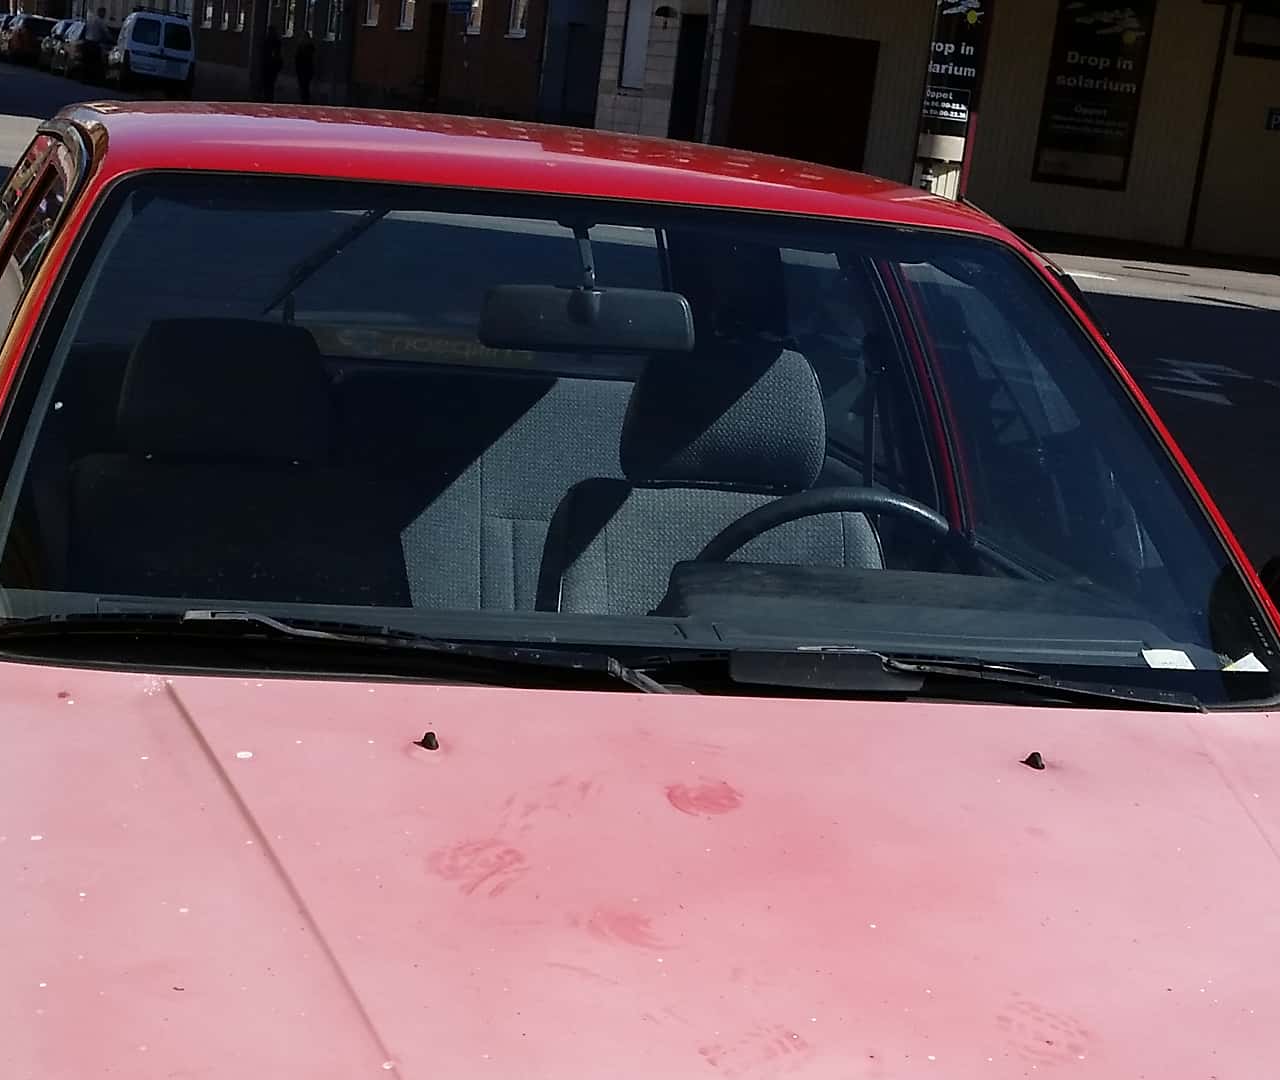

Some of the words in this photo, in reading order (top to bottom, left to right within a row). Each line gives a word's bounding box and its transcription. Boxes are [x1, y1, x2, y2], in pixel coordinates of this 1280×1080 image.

[930, 41, 956, 55] rop
[960, 41, 974, 56] in
[1066, 50, 1111, 70] Drop
[1117, 56, 1134, 71] in
[1055, 73, 1137, 95] solarium
